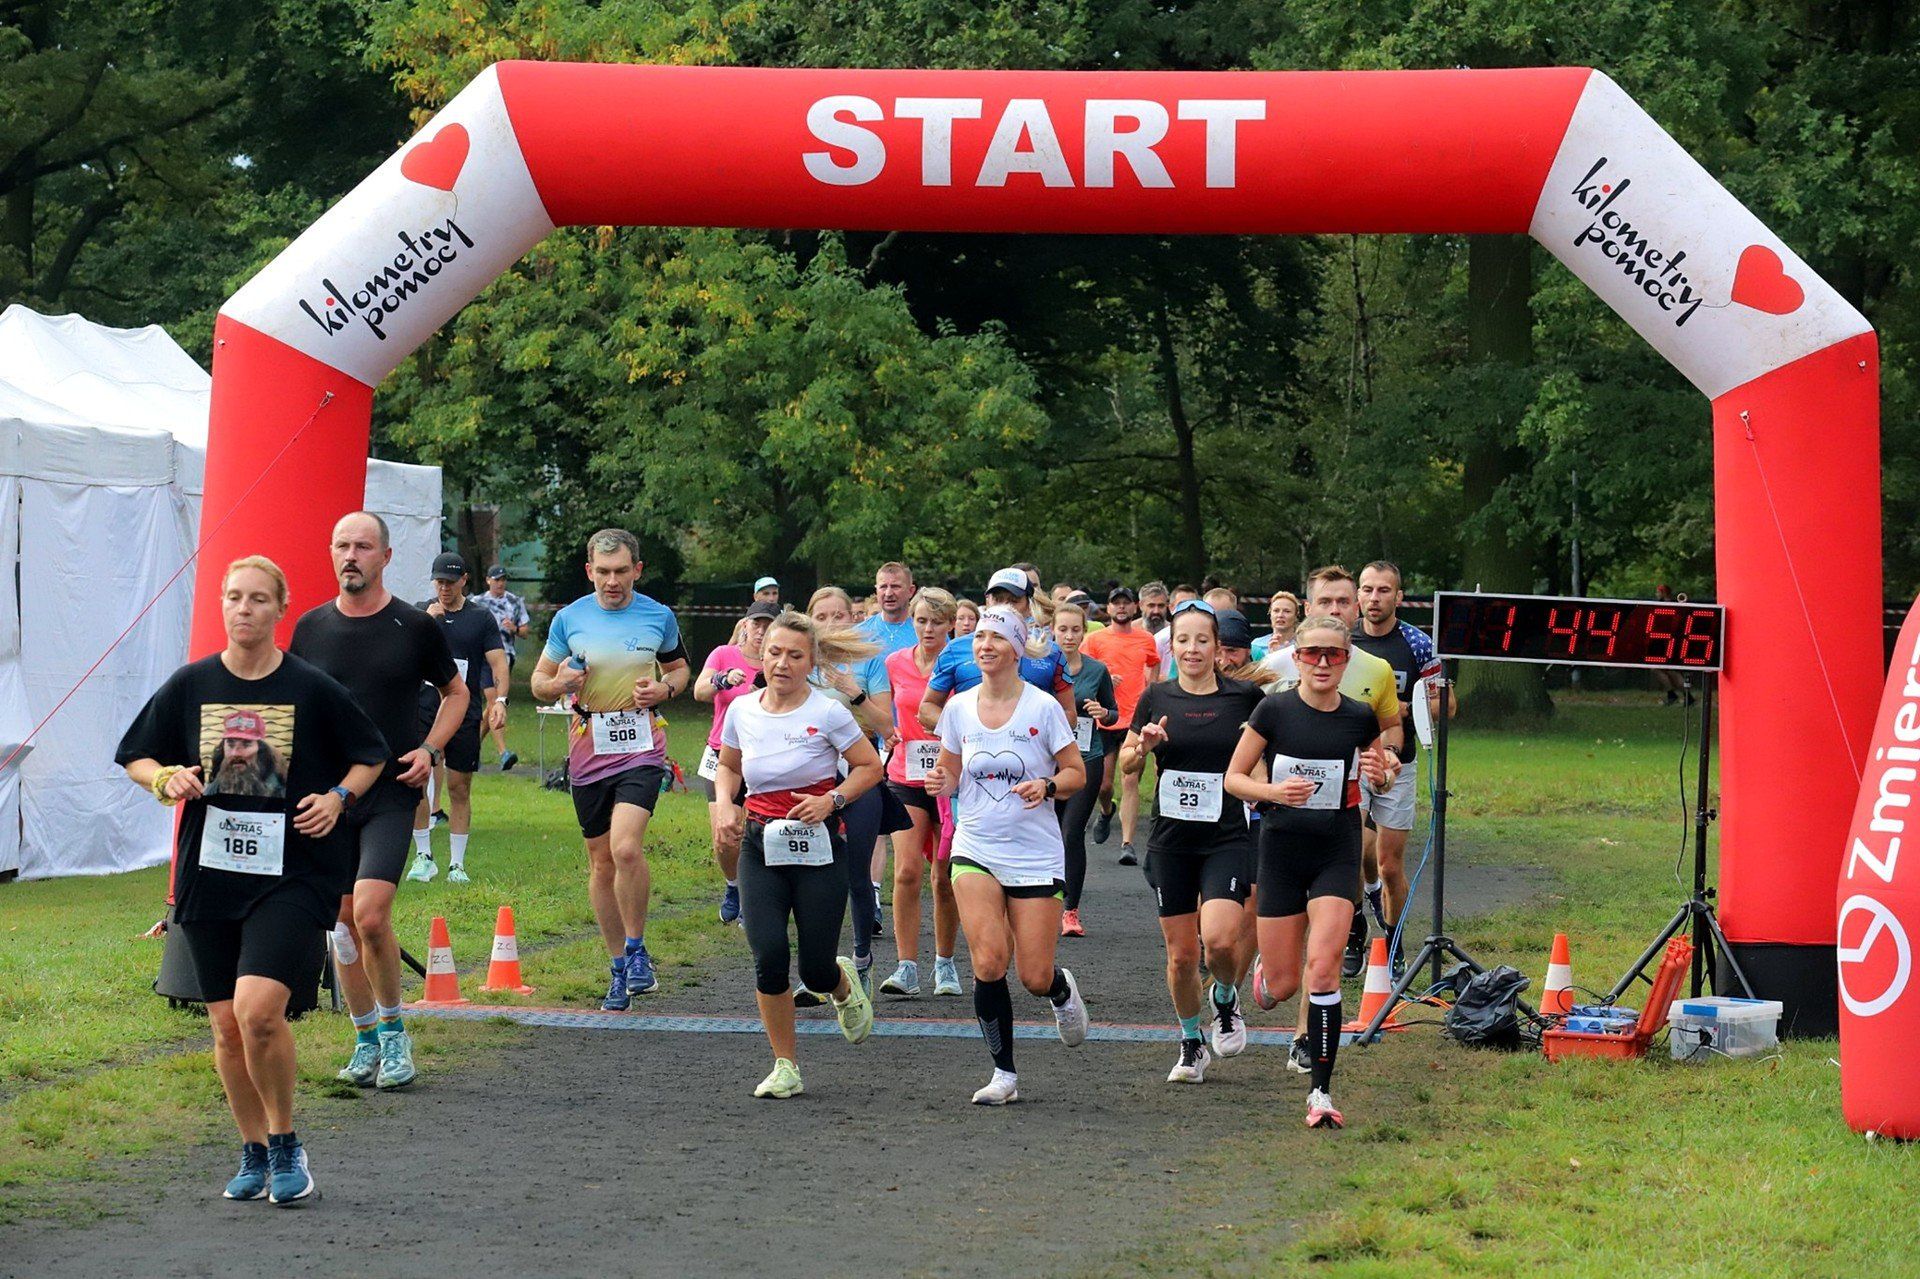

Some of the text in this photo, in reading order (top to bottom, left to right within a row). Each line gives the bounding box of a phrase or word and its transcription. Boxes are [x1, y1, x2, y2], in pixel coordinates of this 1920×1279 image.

[802, 95, 1267, 188] START
[1571, 156, 1703, 327] kilometry
[298, 218, 475, 337] kilometry
[1502, 605, 1714, 665] 1 44 56
[609, 729, 636, 742] 508
[920, 757, 938, 769] 19
[1179, 792, 1199, 807] 23
[224, 837, 258, 856] 186
[788, 840, 809, 853] 98
[496, 942, 513, 951] ZC
[432, 954, 450, 964] ZC
